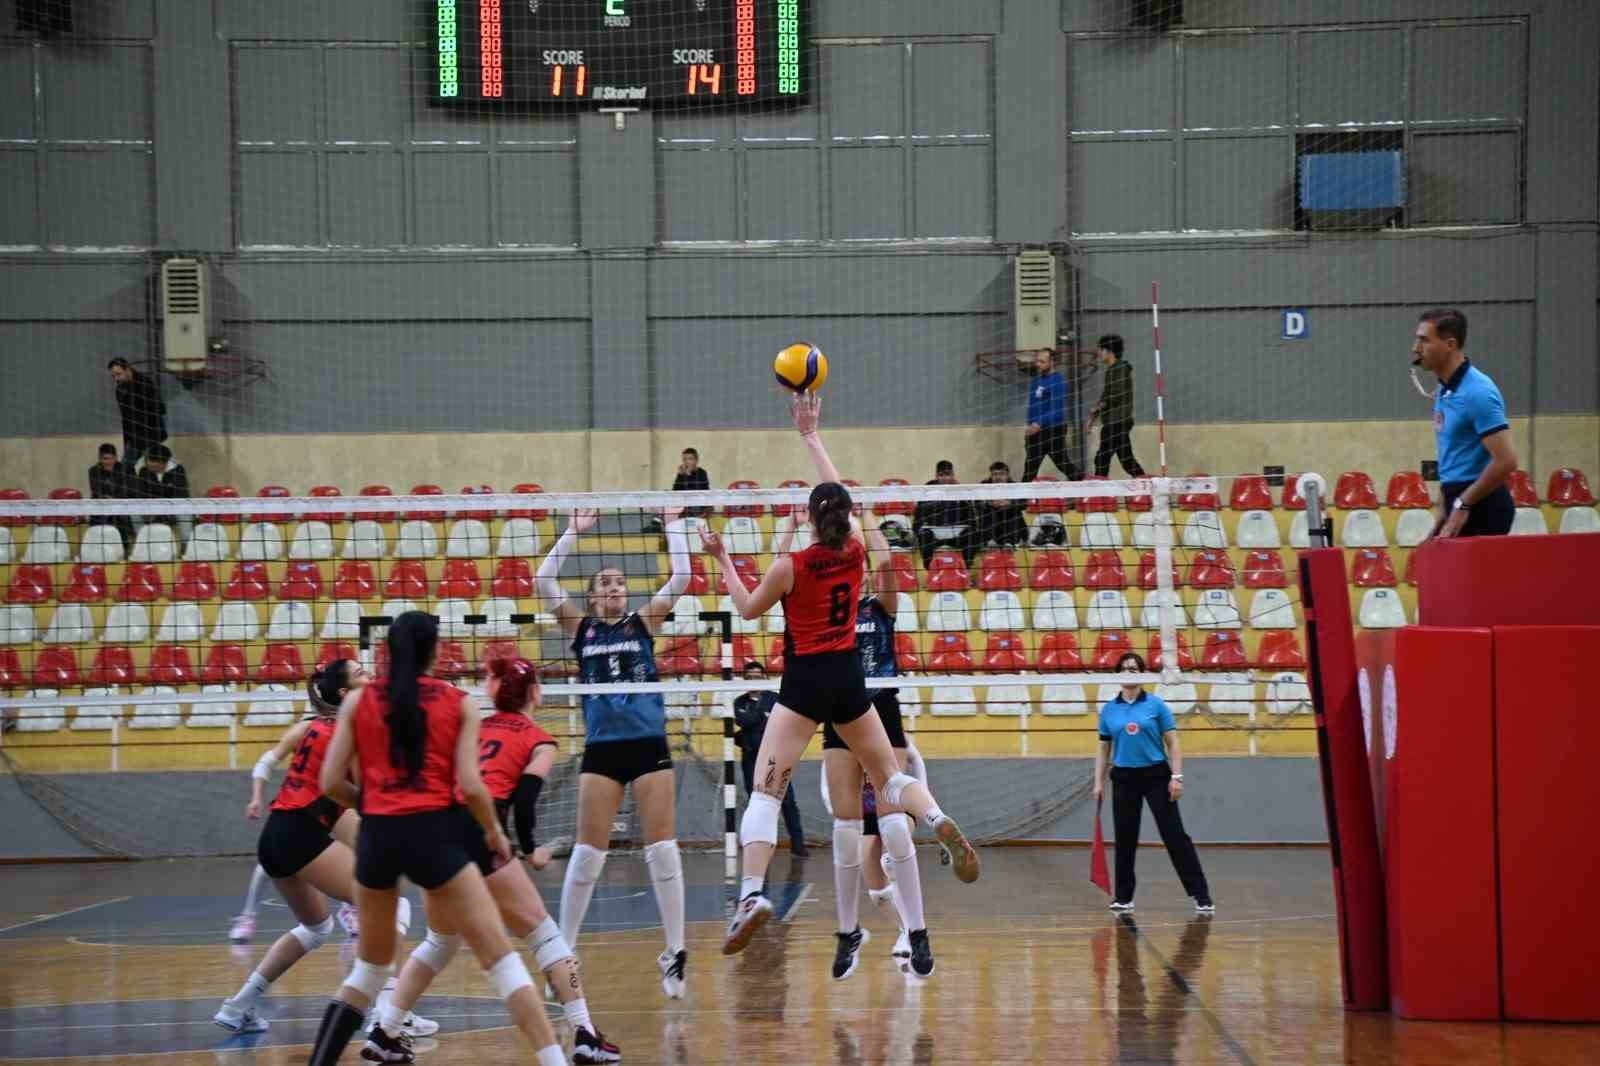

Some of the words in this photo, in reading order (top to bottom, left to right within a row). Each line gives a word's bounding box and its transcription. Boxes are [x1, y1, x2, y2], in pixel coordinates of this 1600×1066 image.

[543, 50, 584, 64] SCORE
[673, 50, 714, 64] SCORE
[552, 65, 585, 96] 11
[688, 64, 721, 94] 14
[1286, 312, 1304, 335] D
[829, 582, 851, 626] 8
